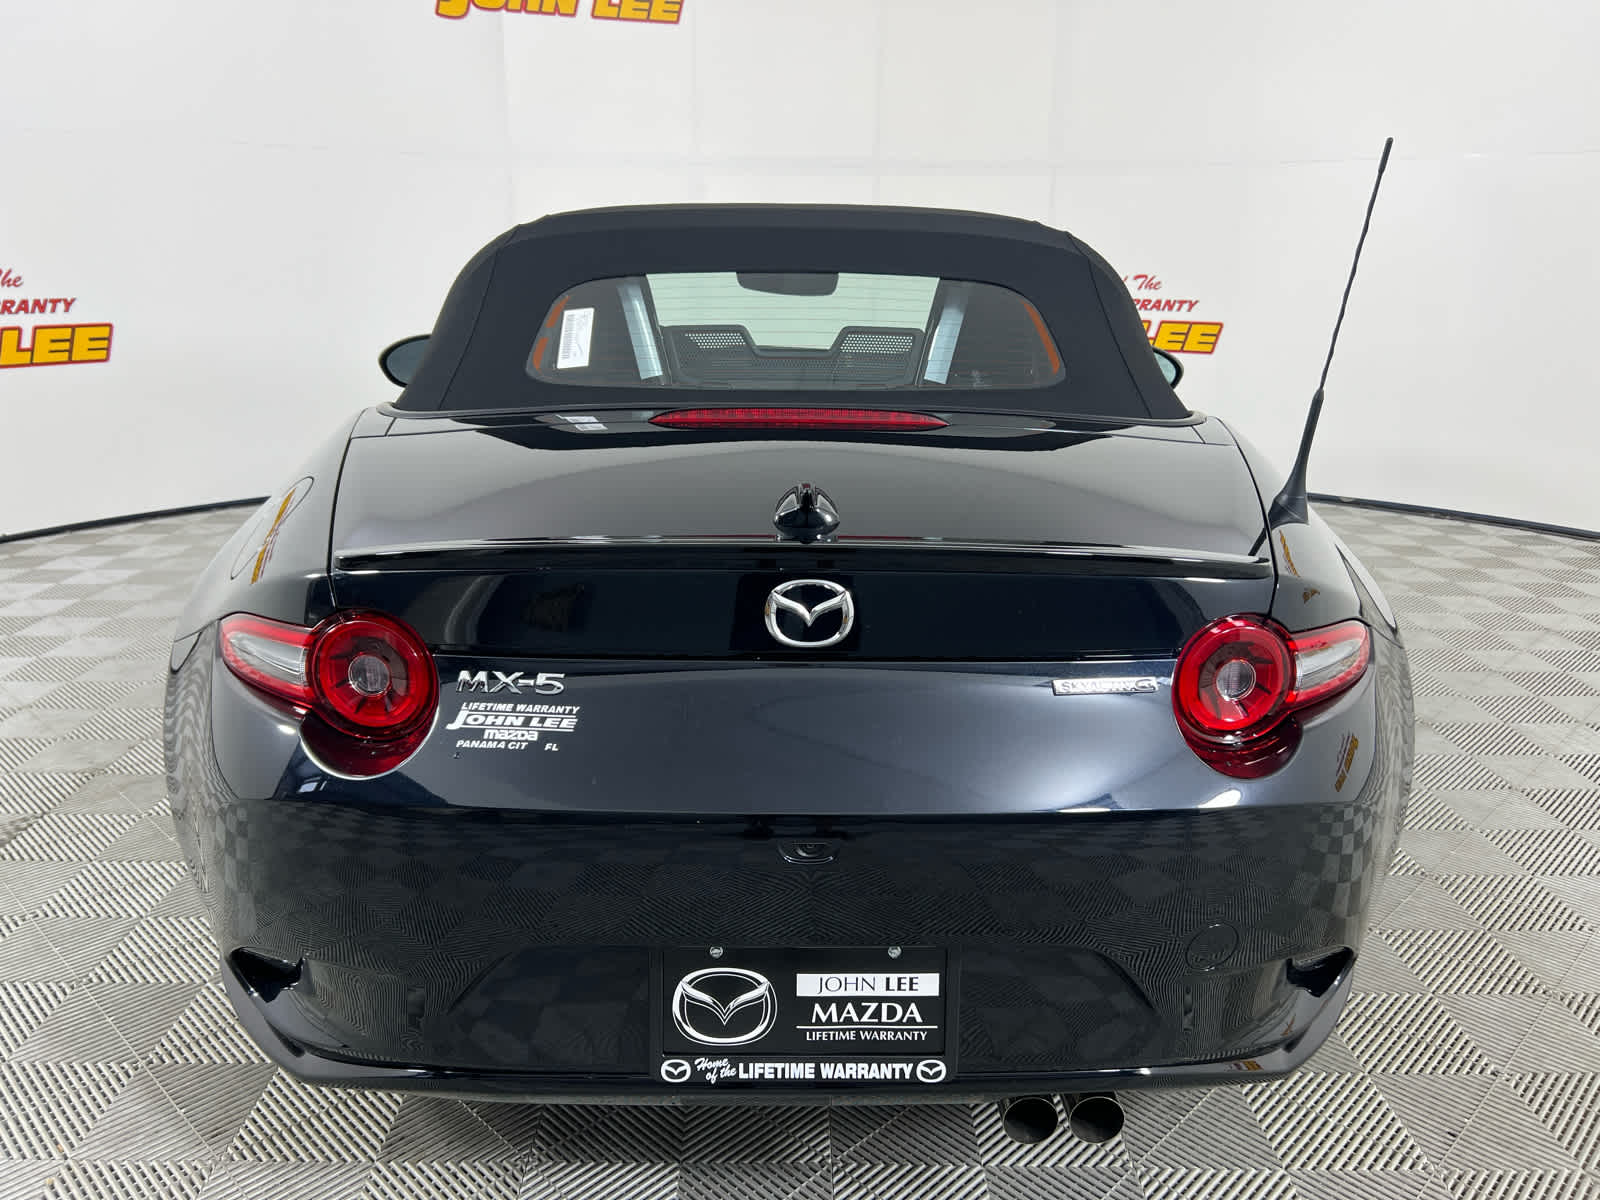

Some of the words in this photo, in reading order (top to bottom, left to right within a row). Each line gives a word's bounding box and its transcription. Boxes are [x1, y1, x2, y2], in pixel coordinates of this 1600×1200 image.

[591, 0, 684, 24] LEE
[0, 267, 24, 288] he
[1133, 274, 1162, 290] The
[0, 297, 76, 315] RANTY
[455, 670, 566, 695] MX-5
[461, 702, 514, 712] LIFETIME
[516, 704, 580, 714] WARRANTY
[446, 710, 522, 730] JOHN
[529, 717, 579, 729] LEE
[456, 740, 505, 749] PANAMA
[544, 743, 559, 751] FL
[817, 976, 876, 994] JOHN
[885, 976, 919, 991] LEE
[811, 1002, 923, 1023] MAZDA
[806, 1031, 856, 1041] LIFETIME
[860, 1031, 928, 1041] WARRANTY
[694, 1057, 729, 1071] Home
[705, 1067, 718, 1084] of
[720, 1064, 737, 1078] the
[739, 1063, 815, 1079] LIFETIME
[820, 1063, 914, 1080] WARRANTY
